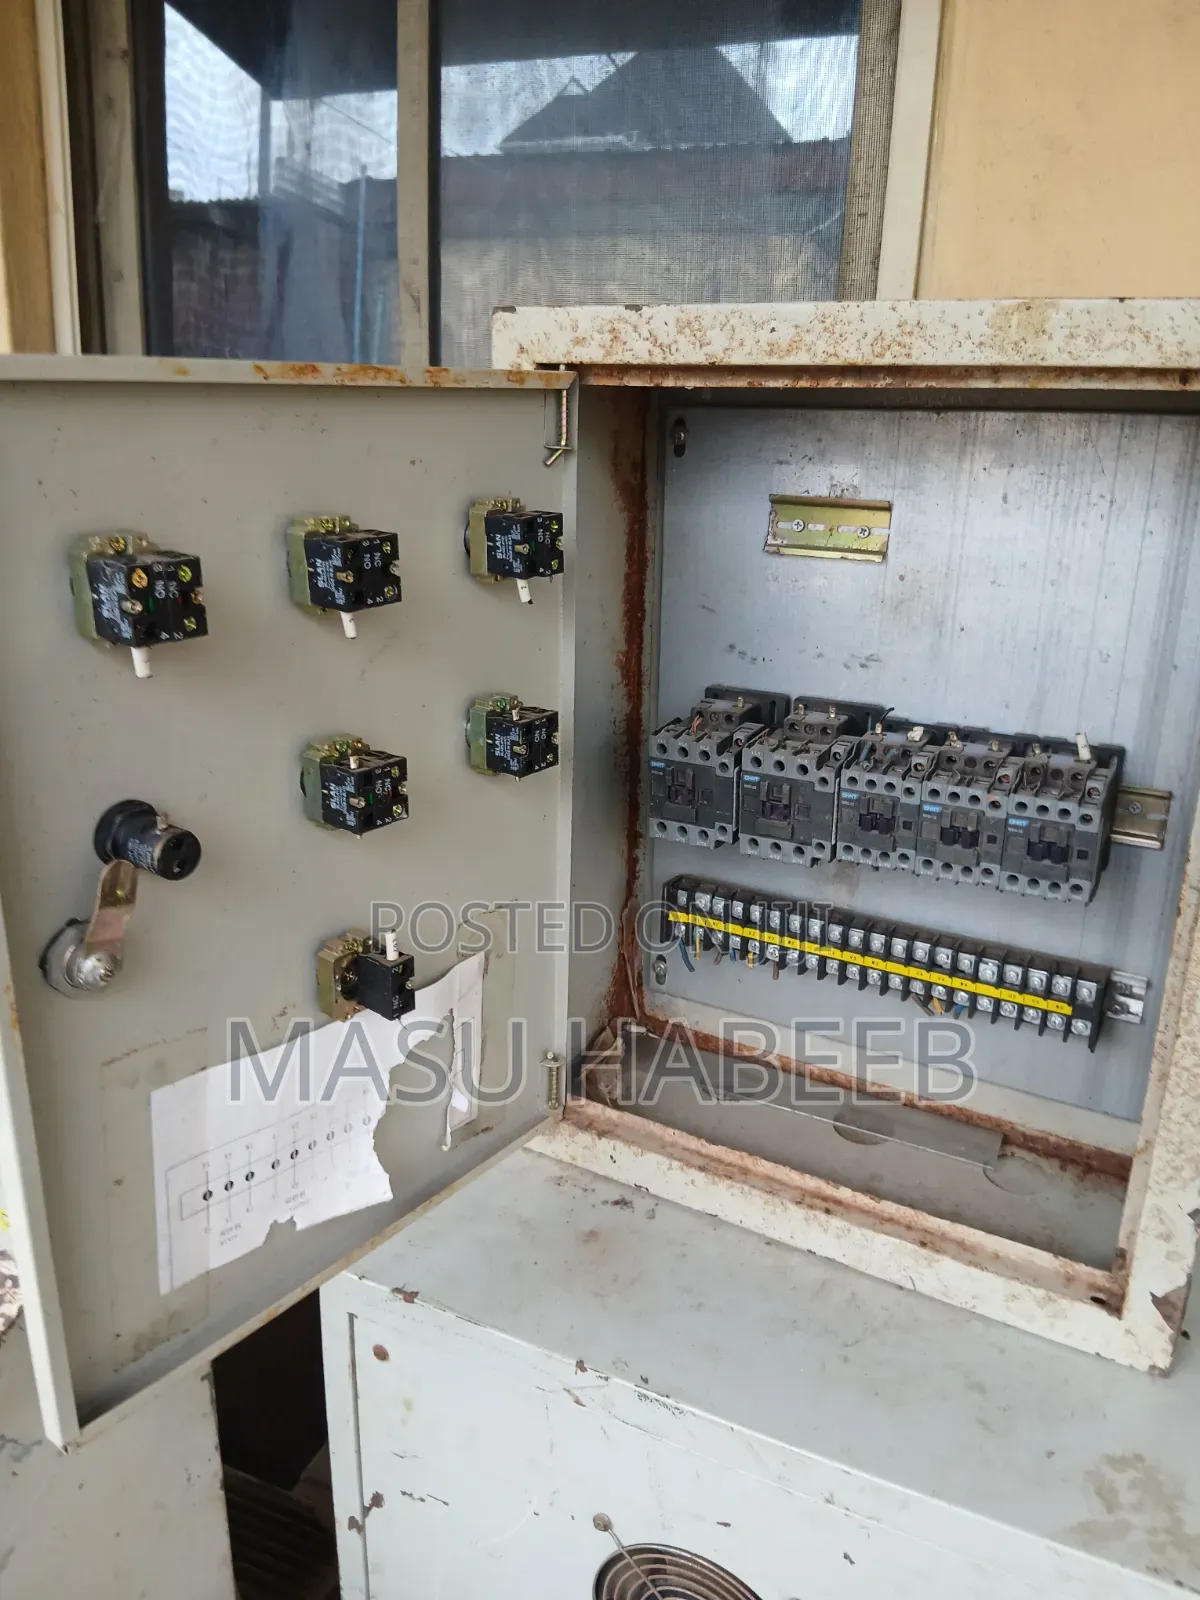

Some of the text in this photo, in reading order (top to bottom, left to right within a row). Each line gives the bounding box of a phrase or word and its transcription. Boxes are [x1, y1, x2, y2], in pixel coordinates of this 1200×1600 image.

[537, 529, 544, 542] NO
[363, 553, 371, 570] NO
[373, 552, 382, 568] NC
[154, 579, 166, 599] NO
[168, 580, 179, 599] NC
[534, 730, 540, 743] NO
[540, 728, 546, 740] NC
[494, 733, 502, 757] SLAN
[375, 780, 383, 794] NO
[384, 778, 392, 792] NC
[392, 994, 399, 1010] NC
